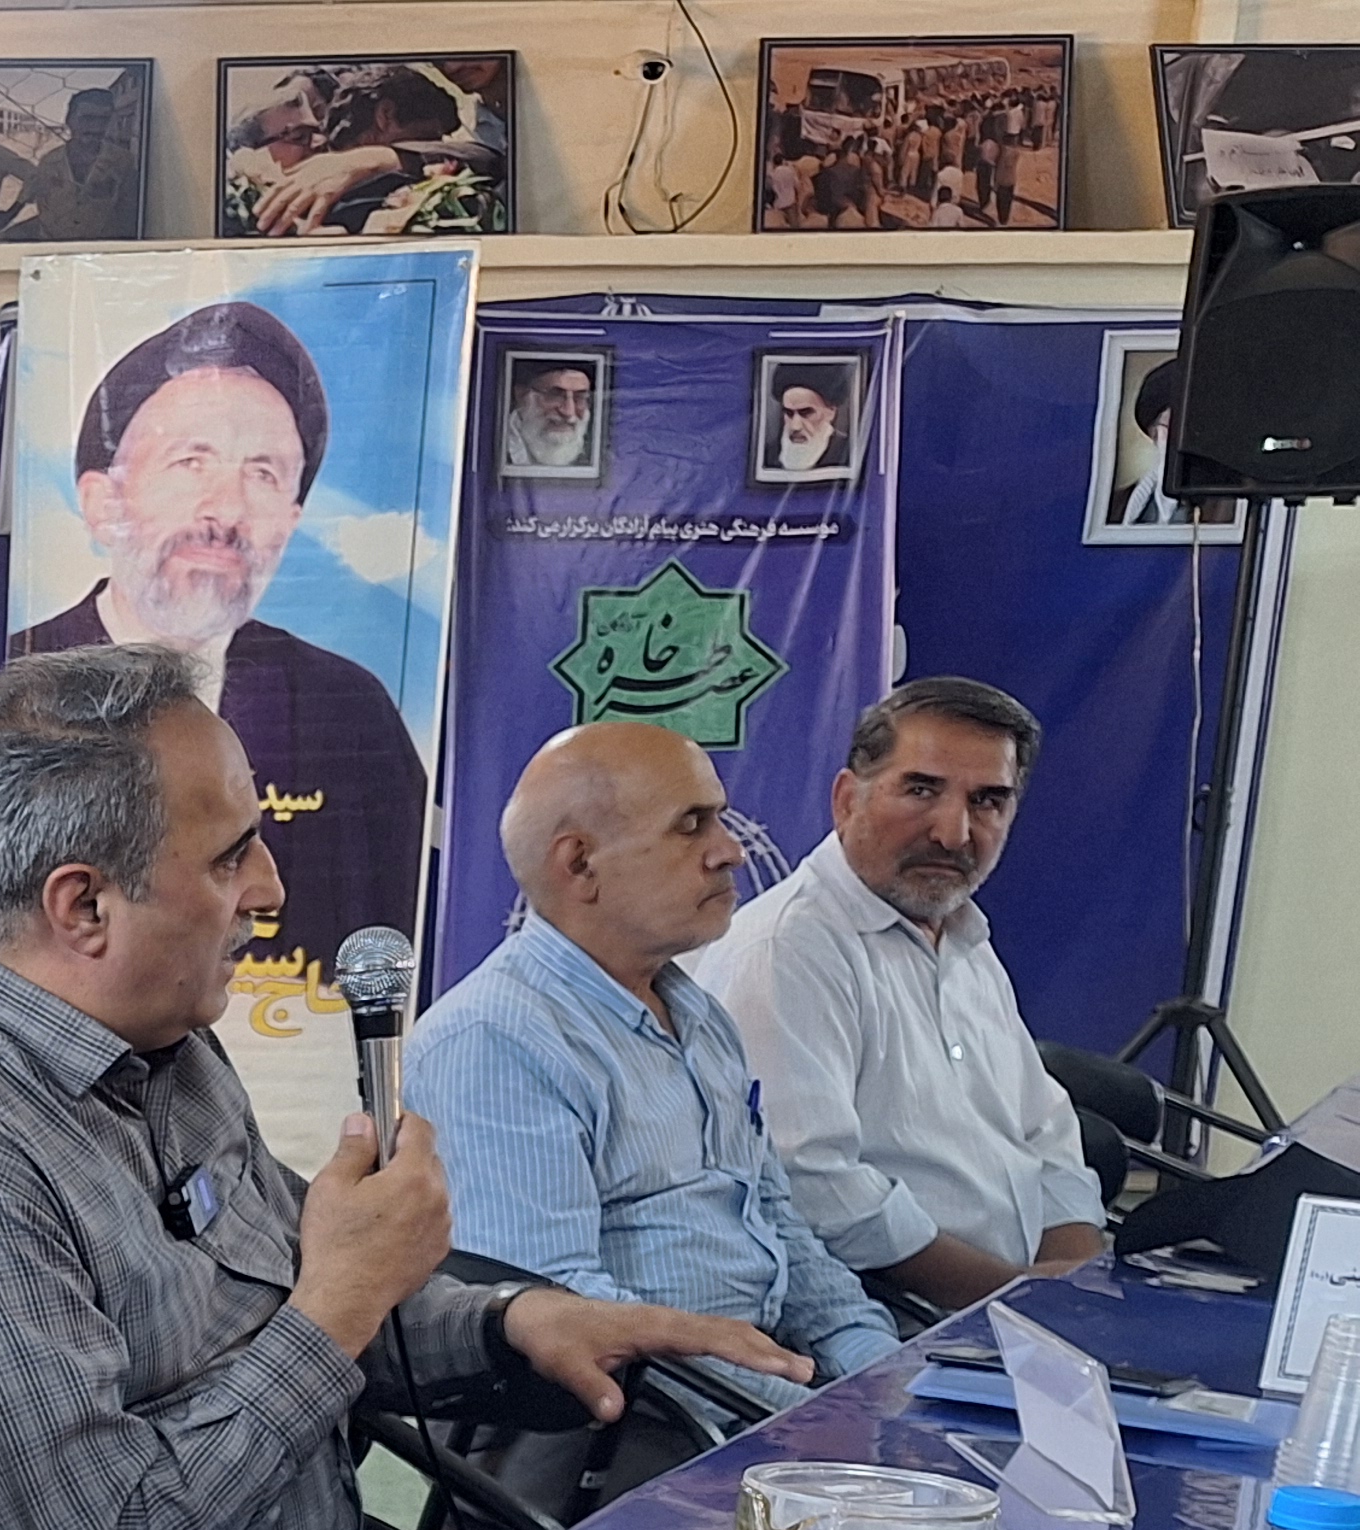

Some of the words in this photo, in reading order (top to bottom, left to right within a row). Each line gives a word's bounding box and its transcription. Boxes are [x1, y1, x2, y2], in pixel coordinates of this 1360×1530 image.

[600, 513, 650, 540] آزادگان
[648, 517, 680, 541] پیام
[679, 520, 720, 541] هنری
[720, 517, 777, 542] فرهنگی
[778, 522, 840, 540] موسسه
